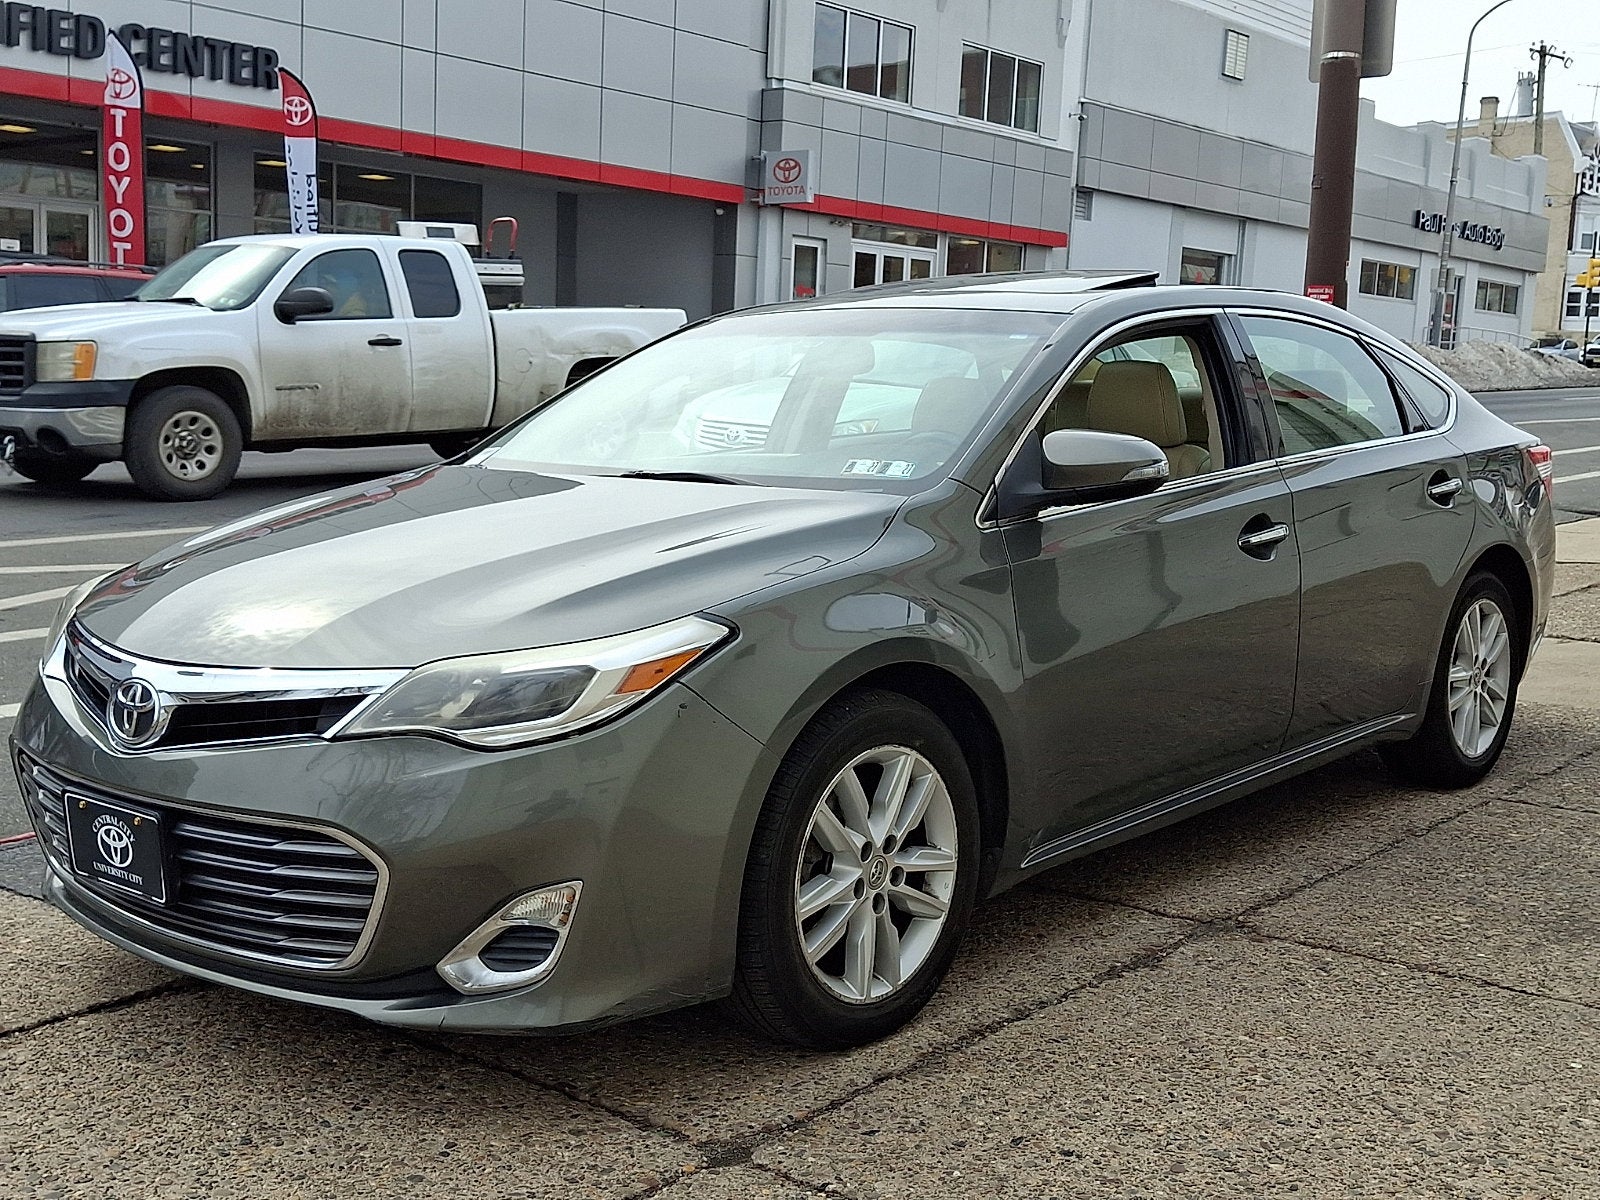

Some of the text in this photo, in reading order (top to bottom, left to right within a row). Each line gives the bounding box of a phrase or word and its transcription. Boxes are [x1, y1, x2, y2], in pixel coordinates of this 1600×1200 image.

[118, 23, 279, 90] CENTER
[108, 108, 134, 269] TOYOT
[768, 185, 806, 196] TOYOTA
[1416, 209, 1441, 234] Paul
[1464, 221, 1485, 242] Auto
[1486, 225, 1506, 250] Body
[92, 814, 136, 842] CENTRAL CITY
[93, 861, 143, 885] UNIVERSITY CITY
